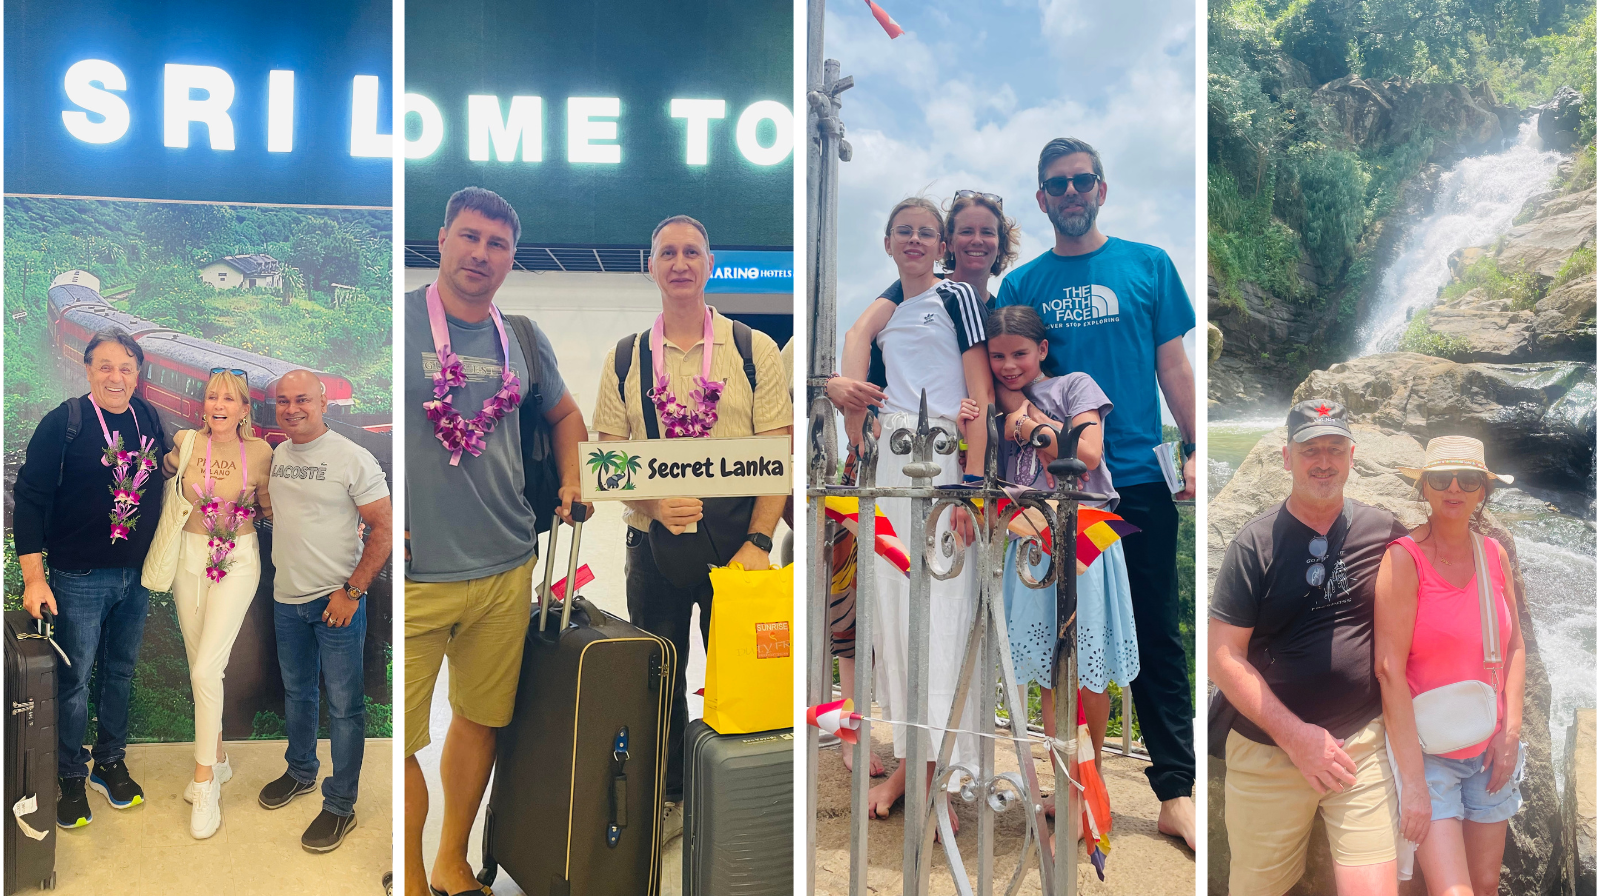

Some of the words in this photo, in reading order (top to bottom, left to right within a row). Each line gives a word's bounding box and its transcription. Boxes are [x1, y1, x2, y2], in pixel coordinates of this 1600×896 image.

[61, 58, 294, 152] SRI
[670, 98, 794, 166] TO
[709, 267, 759, 279] ARINO
[760, 269, 792, 278] HOTELS
[1063, 284, 1090, 298] THE
[1042, 296, 1091, 314] NORTH
[1056, 308, 1091, 322] FACE
[1083, 317, 1120, 327] EXPLORING
[200, 468, 231, 476] MLANO
[271, 464, 328, 481] LACOSTE
[648, 457, 715, 480] Secret
[720, 456, 784, 478] Lanka
[756, 622, 788, 632] SUNRISE
